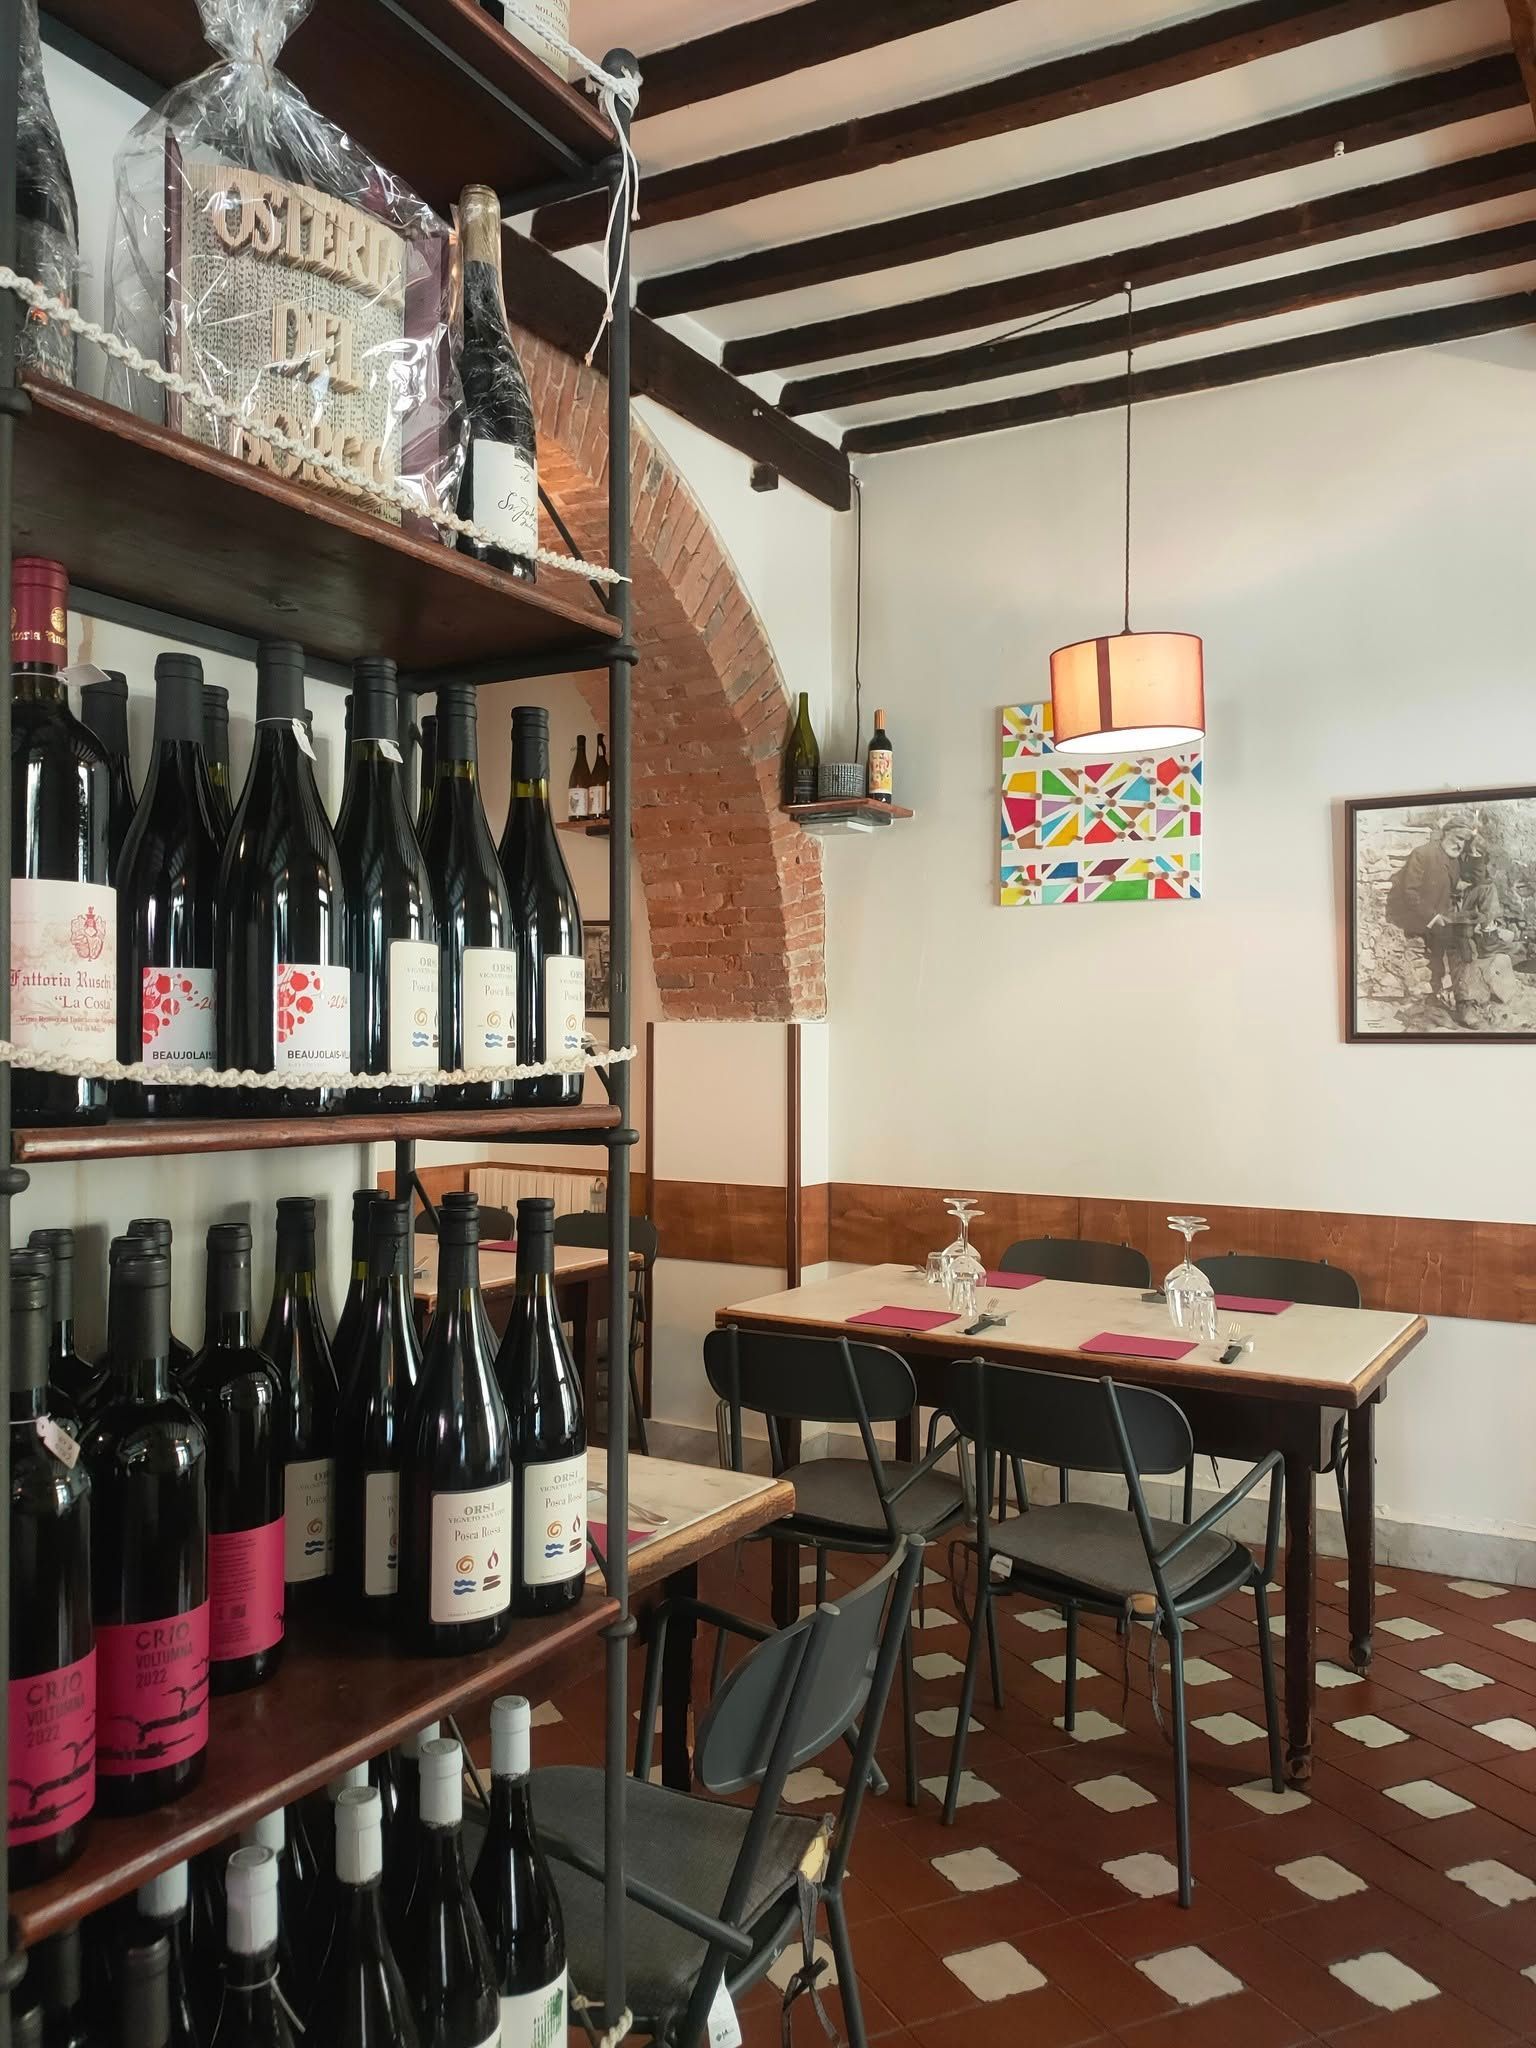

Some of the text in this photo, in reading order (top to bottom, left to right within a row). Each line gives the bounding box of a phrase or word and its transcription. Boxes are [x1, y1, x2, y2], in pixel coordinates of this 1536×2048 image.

[212, 172, 405, 300] OSTERIA
[554, 1470, 579, 1484] ORSI
[464, 1502, 495, 1516] ORSI
[448, 1514, 481, 1524] VIGNETO
[455, 1530, 479, 1542] Posca
[136, 1622, 190, 1649] CRIO
[27, 1669, 82, 1705] CRIO
[136, 1669, 168, 1689] 2022
